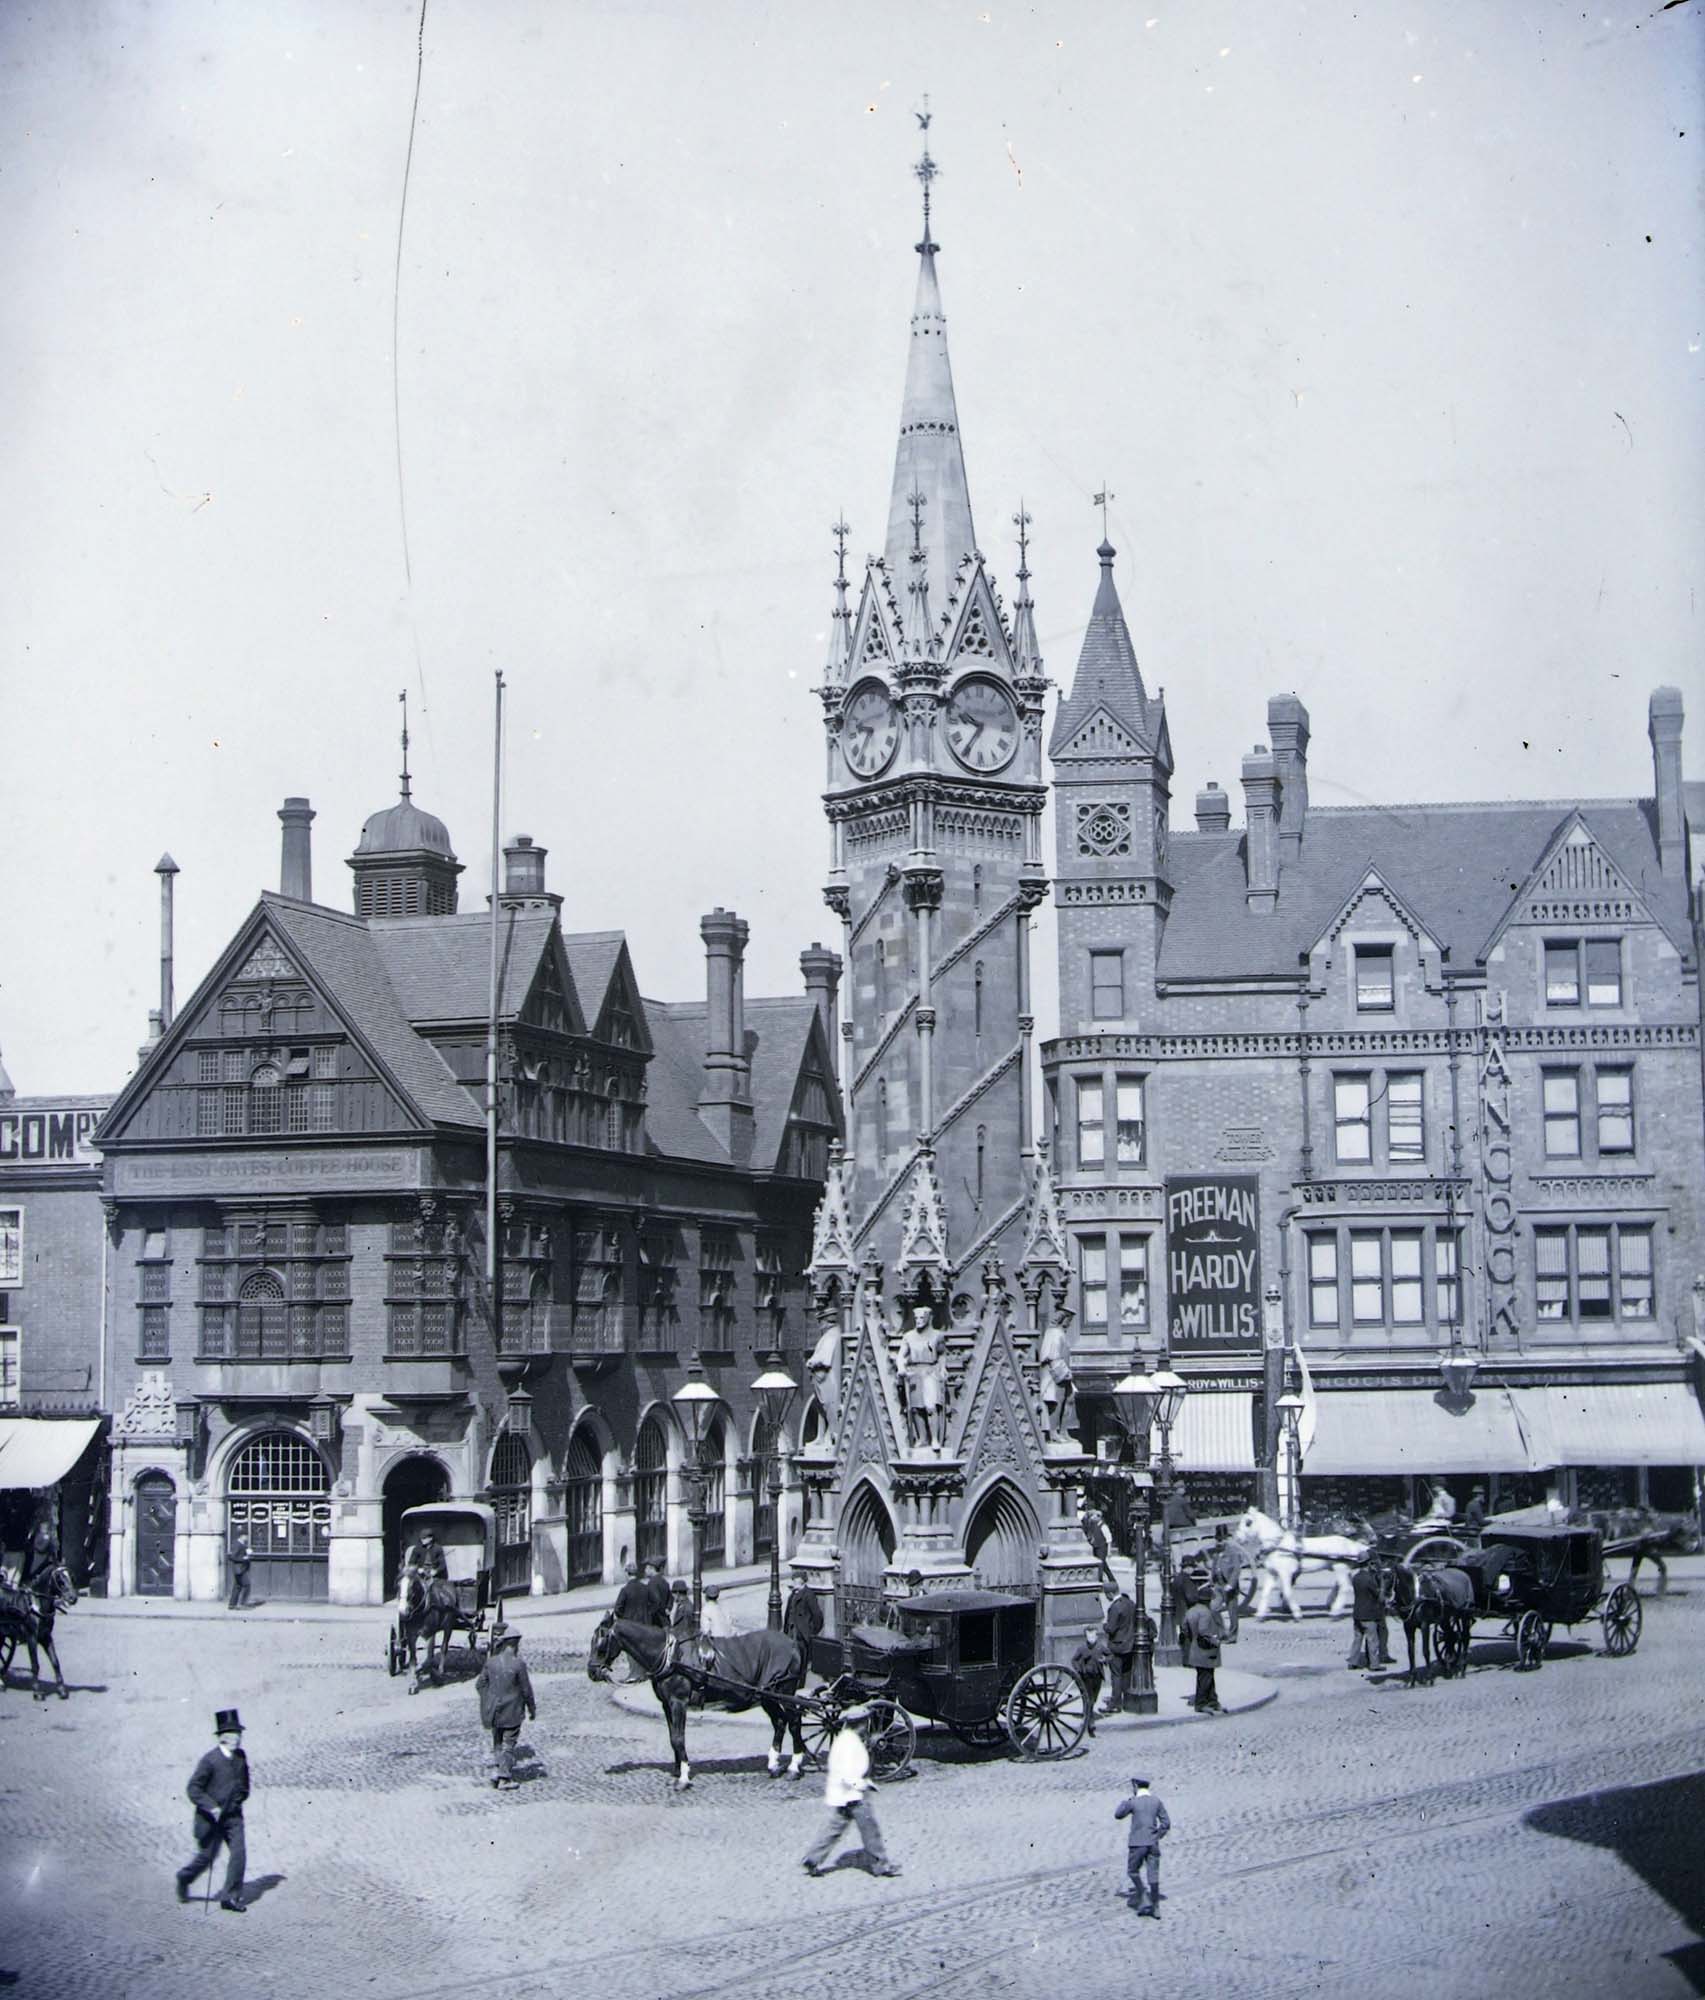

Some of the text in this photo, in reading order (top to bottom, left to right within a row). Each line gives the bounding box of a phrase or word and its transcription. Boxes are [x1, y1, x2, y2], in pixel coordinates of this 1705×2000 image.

[345, 1156, 402, 1173] HOUSE
[1479, 990, 1520, 1336] HANCOCK
[1169, 1186, 1256, 1233] FREEMAN
[1171, 1250, 1256, 1294] HARDY
